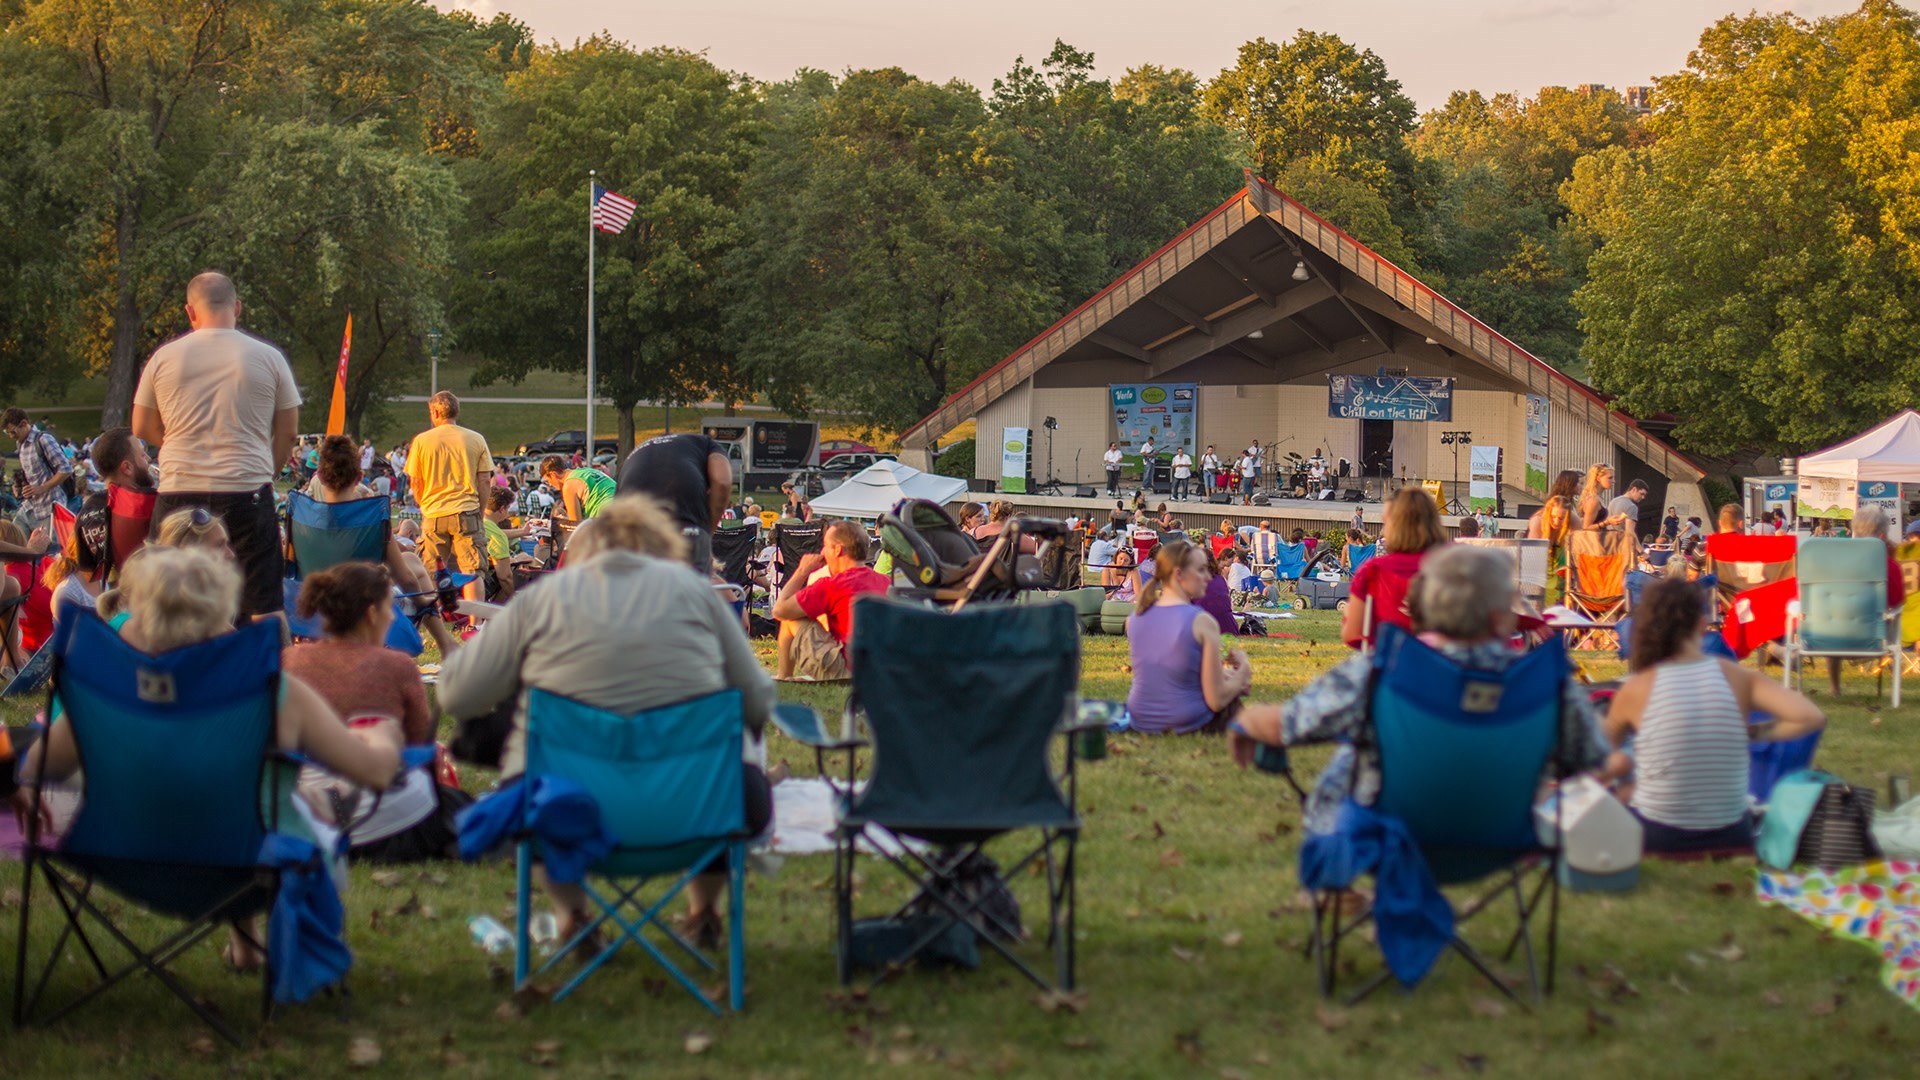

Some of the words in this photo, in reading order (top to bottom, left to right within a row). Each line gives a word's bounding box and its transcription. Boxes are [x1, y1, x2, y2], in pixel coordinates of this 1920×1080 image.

[1340, 405, 1366, 417] Chill
[1368, 409, 1385, 418] on
[1408, 407, 1427, 420] Hill
[1881, 500, 1897, 509] PARK
